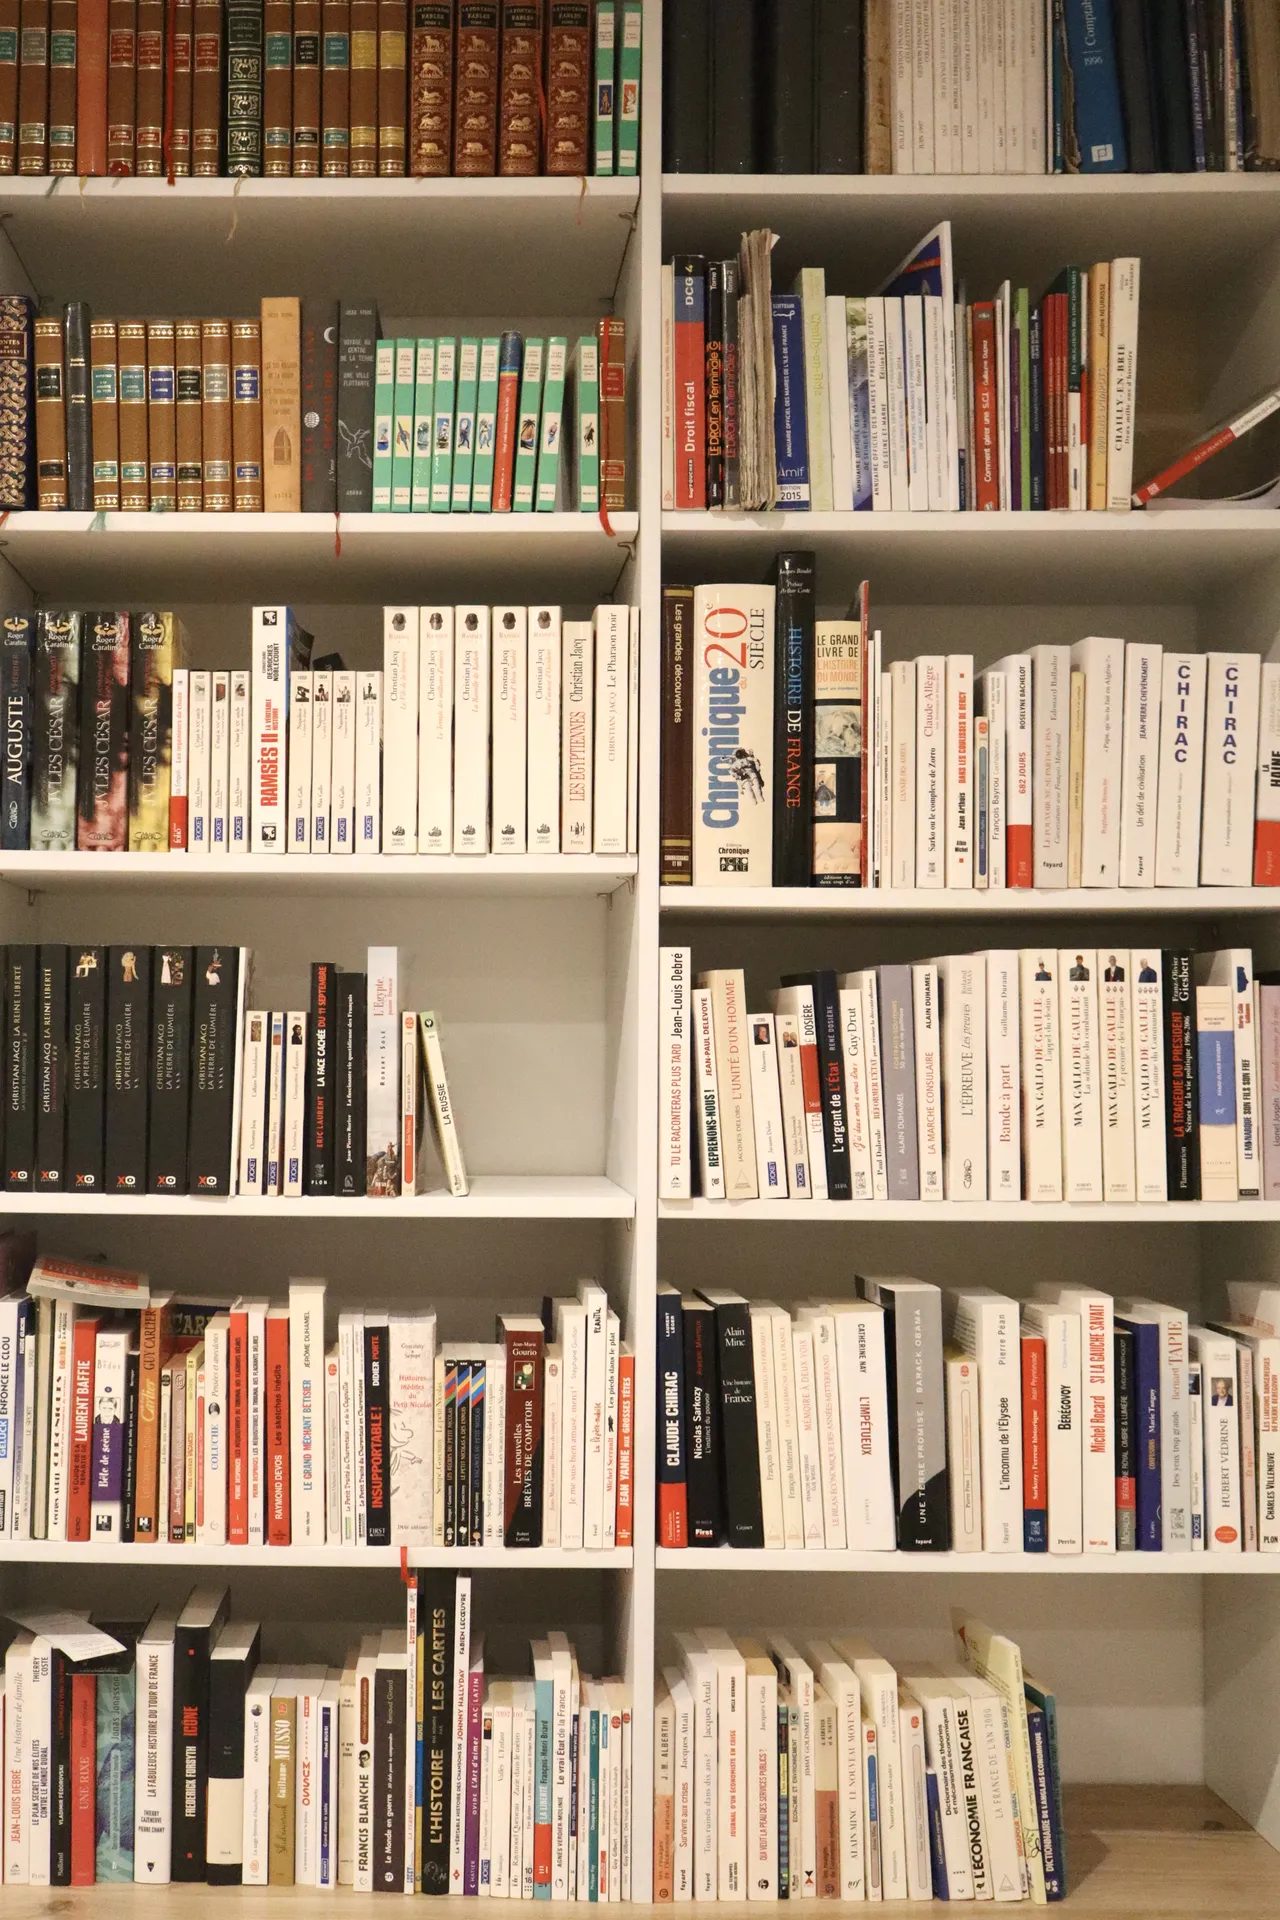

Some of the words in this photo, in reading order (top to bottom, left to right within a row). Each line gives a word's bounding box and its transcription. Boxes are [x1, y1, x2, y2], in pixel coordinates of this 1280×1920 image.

[1084, 56, 1104, 66] 1996
[685, 277, 693, 305] DCG
[710, 341, 719, 350] G
[710, 353, 719, 399] Terminale
[684, 381, 695, 416] fiscal
[711, 401, 719, 414] en
[685, 421, 695, 451] Droit
[709, 417, 719, 445] DROIT
[710, 446, 719, 456] LE
[781, 492, 801, 500] 2015
[607, 613, 617, 632] noir
[675, 604, 683, 621] Les
[570, 639, 586, 658] Jacq
[607, 635, 618, 672] Pharaon
[674, 624, 684, 661] grandes
[748, 608, 765, 670] SIÈCLE
[501, 650, 510, 665] Jacq
[788, 627, 802, 704] HISTOIRE
[500, 667, 508, 700] Christian
[570, 661, 583, 702] Christian
[607, 676, 616, 688] Le
[674, 664, 683, 723] découvertes
[924, 666, 935, 701] Allègre
[264, 699, 272, 721] VÉRITABLE
[608, 692, 617, 713] JACQ
[1175, 665, 1191, 763] CHIRAC
[1223, 667, 1239, 764] CHIRAC
[47, 697, 63, 751] CÉSAR
[93, 700, 111, 753] CÉSAR
[265, 723, 272, 731] LA
[787, 710, 801, 733] DE
[924, 704, 934, 737] Claude
[7, 696, 23, 785] AUGUSTE
[261, 733, 278, 743] II
[570, 712, 585, 780] EGYPTIENNES
[701, 667, 746, 828] Chronique
[257, 747, 278, 806] RAMSÈS
[786, 738, 801, 808] FRANCE
[1018, 752, 1026, 778] JOURS
[570, 783, 585, 801] LES
[1018, 780, 1026, 794] 682
[296, 818, 304, 841] POCKET
[671, 953, 683, 981] Debré
[1179, 957, 1190, 1001] Giesbert
[43, 968, 52, 999] LIBERTÉ
[318, 966, 326, 1006] SEPTEMBRE
[318, 1016, 326, 1027] DU
[671, 984, 683, 1039] Jean-Louis
[847, 1008, 856, 1032] Drut
[44, 1028, 51, 1038] LA
[316, 1029, 326, 1056] CACHÉE
[848, 1035, 860, 1056] Guy
[317, 1058, 325, 1075] FACE
[672, 1044, 681, 1064] TARD
[317, 1077, 325, 1087] LA
[672, 1066, 681, 1087] PLUS
[827, 1062, 840, 1092] L'État
[1000, 1064, 1013, 1089] part
[1173, 1064, 1183, 1077] DU
[437, 1083, 449, 1112] RUSSIE
[830, 1095, 840, 1106] de
[443, 1114, 451, 1125] LA
[671, 1089, 681, 1142] RACONTERAS
[1000, 1104, 1011, 1142] Bande
[705, 1094, 719, 1167] REPRENONS-NOUS
[831, 1109, 845, 1152] L'argent
[1173, 1126, 1184, 1137] LA
[671, 1144, 681, 1154] LE
[671, 1156, 681, 1166] TU
[290, 1158, 298, 1183] POCKET
[1180, 1147, 1188, 1188] Flammarion
[1089, 1304, 1104, 1331] SAVAIT
[1, 1336, 10, 1359] CLOU
[1089, 1333, 1105, 1362] GAUCHE
[1168, 1321, 1183, 1365] TAPIE
[1, 1360, 10, 1372] LE
[77, 1360, 90, 1394] BAFFIE
[1091, 1364, 1104, 1373] LA
[1091, 1376, 1104, 1384] SI
[0, 1375, 10, 1415] ENFONCE
[665, 1372, 678, 1416] CHIRAC
[1172, 1368, 1180, 1400] Bernard
[693, 1387, 704, 1421] Sarkozy
[997, 1398, 1010, 1431] l'Élysée
[1058, 1385, 1071, 1430] BÉRÉGOVOY
[1090, 1396, 1105, 1423] Rocard
[75, 1397, 90, 1441] LAURENT
[524, 1400, 533, 1451] COMPTOIR
[860, 1396, 873, 1455] L'IMPÉTUEUX
[210, 1424, 219, 1470] COLUCHE
[666, 1420, 680, 1466] CLAUDE
[693, 1425, 703, 1458] Nicolas
[999, 1433, 1009, 1445] de
[1091, 1426, 1106, 1452] Michel
[1219, 1418, 1229, 1463] VÉDRINE
[274, 1455, 282, 1481] DEVOS
[371, 1412, 382, 1508] INSUPPORTABLE
[524, 1454, 532, 1466] DE
[999, 1446, 1010, 1490] L'inconnu
[1266, 1452, 1275, 1490] VILLENEUVE
[514, 1468, 522, 1484] Les
[522, 1469, 532, 1507] BRÈVES
[1221, 1467, 1230, 1507] HUBERT
[274, 1482, 283, 1519] RAYMOND
[1266, 1491, 1275, 1520] CHARLES
[431, 1608, 445, 1676] CARTES
[432, 1681, 445, 1710] LES
[558, 1690, 566, 1717] France
[181, 1706, 198, 1736] ICÔNE
[558, 1720, 566, 1728] la
[558, 1730, 566, 1738] de
[681, 1712, 689, 1735] Attali
[274, 1720, 290, 1760] MUSSO
[556, 1741, 566, 1755] État
[680, 1737, 690, 1769] Jacques
[957, 1710, 975, 1789] FRANÇAISE
[185, 1746, 196, 1777] FORSYTH
[557, 1757, 566, 1774] vrai
[11, 1770, 20, 1794] DEBRÉ
[557, 1776, 566, 1784] Le
[679, 1783, 689, 1803] crises
[185, 1779, 196, 1817] FREDERICK
[358, 1774, 369, 1823] BLANCHE
[429, 1750, 444, 1843] L'HISTOIRE
[681, 1805, 689, 1816] aux
[11, 1797, 21, 1843] JEAN-LOUIS
[678, 1818, 688, 1847] Survivre
[358, 1827, 369, 1871] FRANCIS
